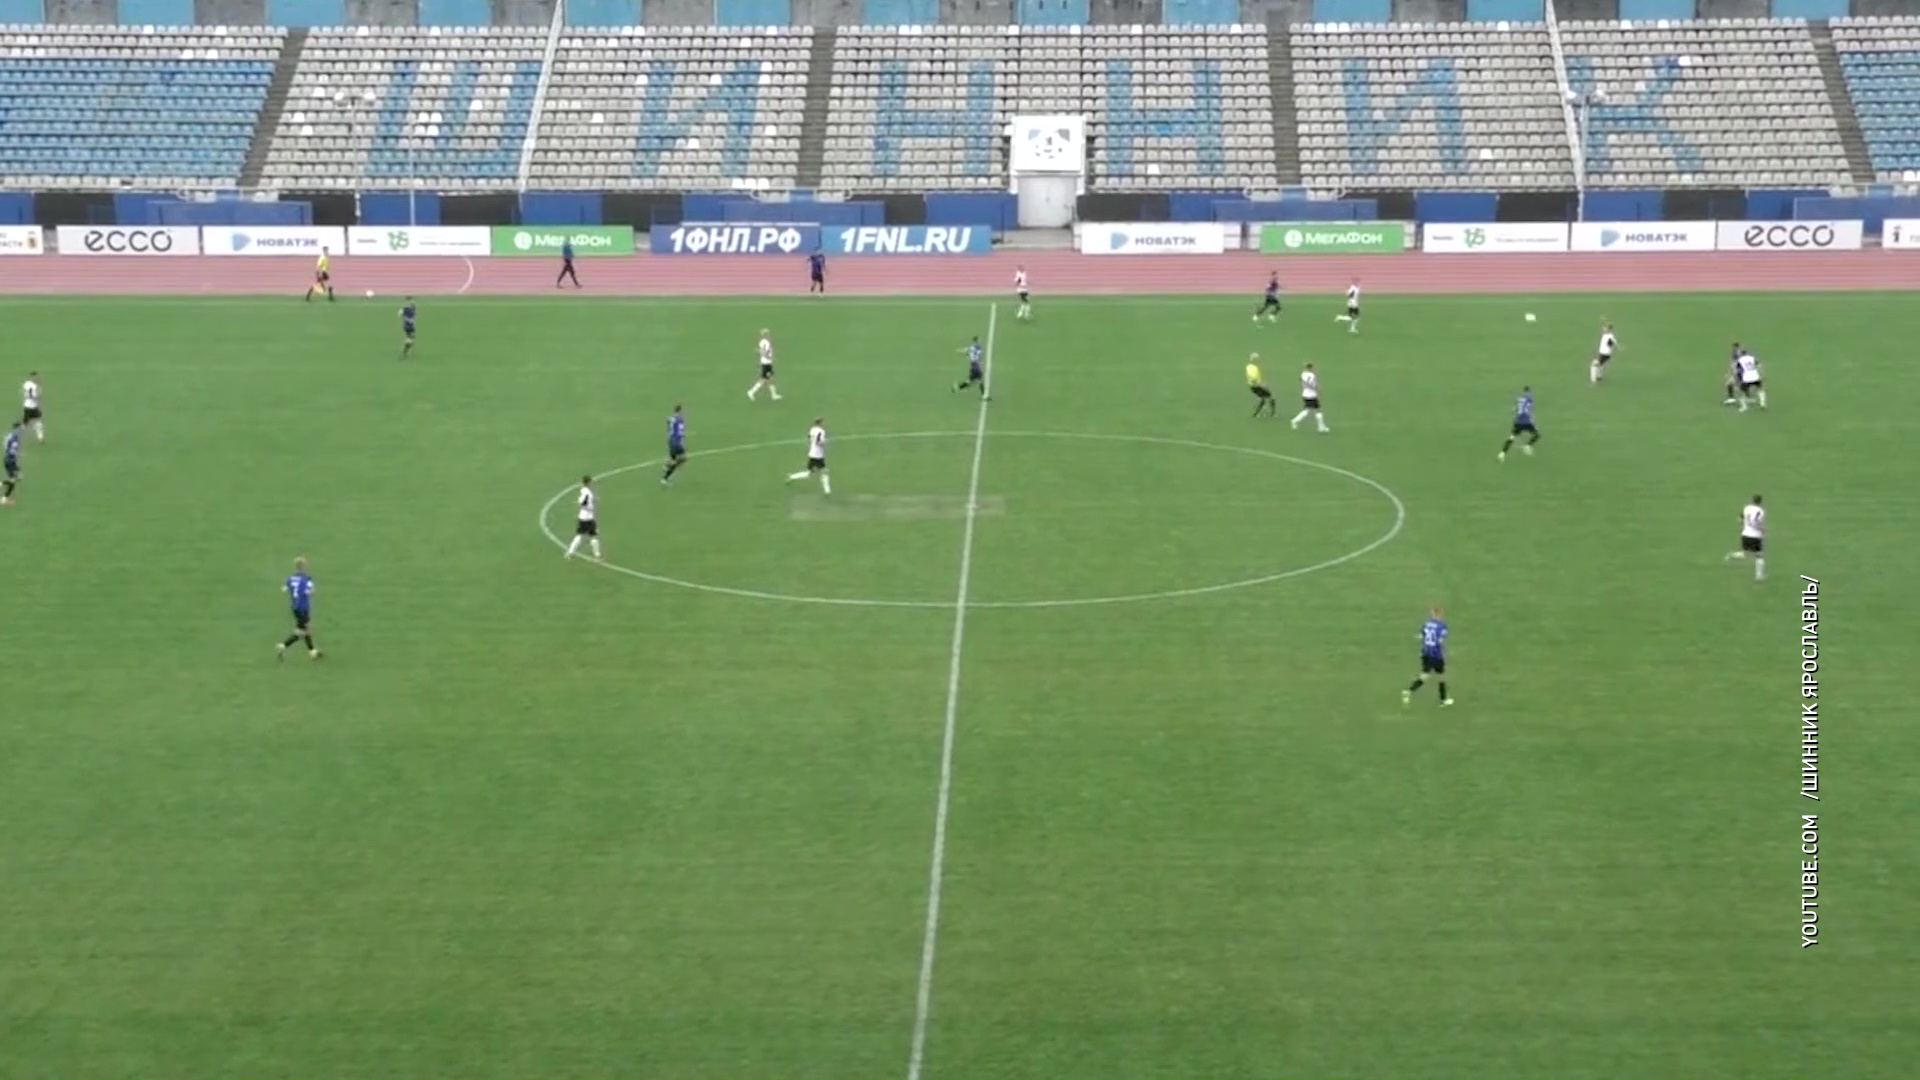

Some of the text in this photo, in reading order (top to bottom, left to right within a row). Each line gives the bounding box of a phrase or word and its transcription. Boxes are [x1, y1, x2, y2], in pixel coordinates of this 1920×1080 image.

[366, 58, 1704, 177] ШИННИК
[256, 238, 319, 247] НОВАТЭК
[670, 227, 802, 253] 1ФНЛ.РФ
[840, 227, 972, 253] 1FNL.RU
[1134, 236, 1197, 247] НОВАТЭК
[1625, 232, 1689, 243] НОВАТЭК
